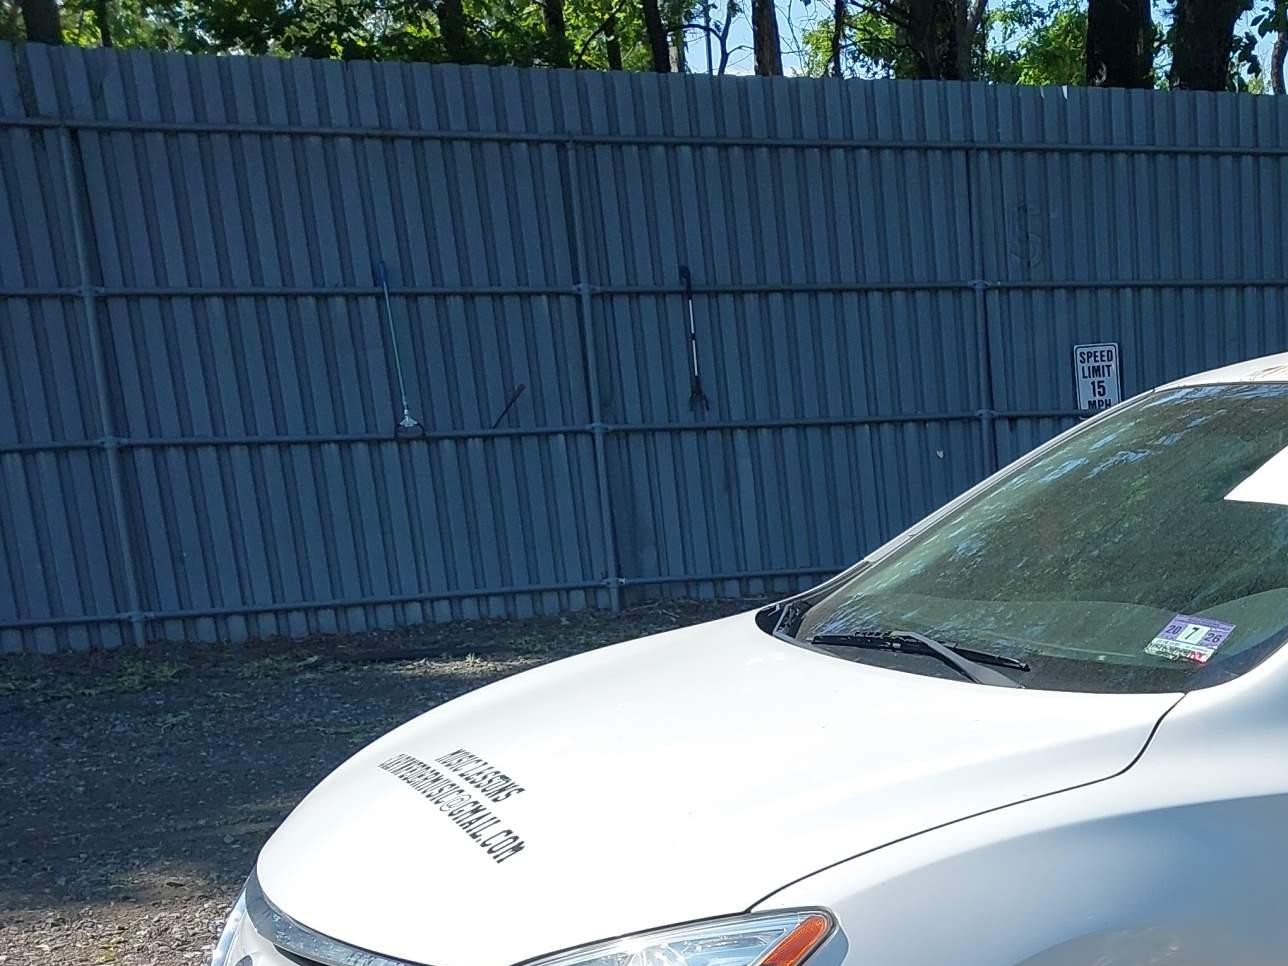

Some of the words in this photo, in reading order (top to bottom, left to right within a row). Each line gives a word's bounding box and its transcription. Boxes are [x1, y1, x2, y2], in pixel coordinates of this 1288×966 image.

[1079, 350, 1113, 364] SPEED
[1082, 365, 1112, 379] LIMIT
[1091, 380, 1106, 397] 15
[1088, 399, 1112, 410] MPH
[1166, 625, 1182, 635] 20
[1185, 627, 1199, 640] 7
[1205, 633, 1222, 643] 26
[435, 748, 483, 772] MUSIC
[458, 761, 526, 803] LESSONS
